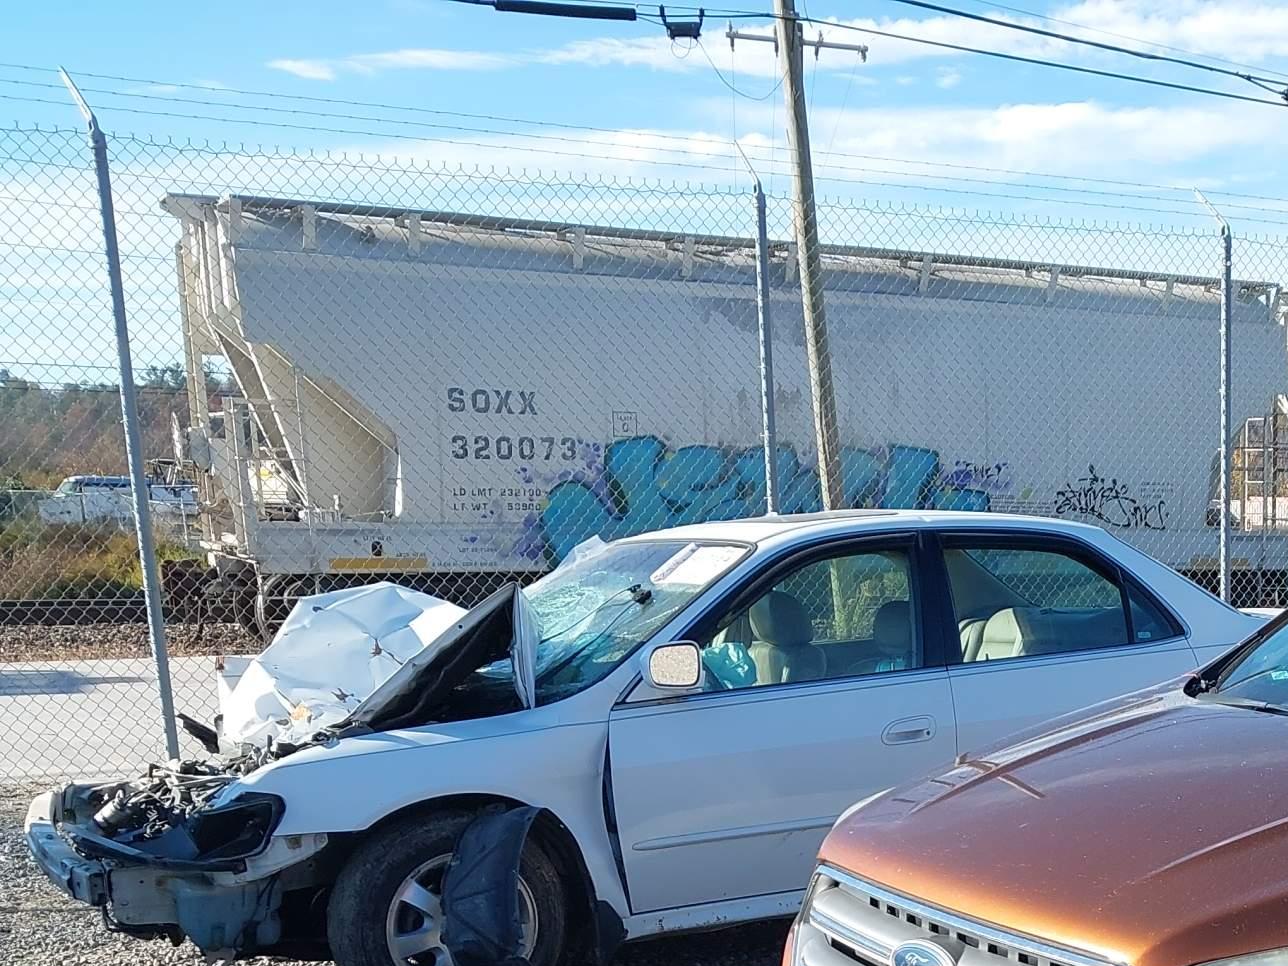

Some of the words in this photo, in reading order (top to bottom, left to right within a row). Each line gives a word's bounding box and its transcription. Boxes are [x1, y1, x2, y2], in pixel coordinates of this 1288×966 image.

[447, 387, 538, 415] SOXX
[451, 435, 577, 460] 320073
[453, 488, 466, 496] LD
[471, 488, 493, 496] LMT
[471, 503, 488, 511] WT
